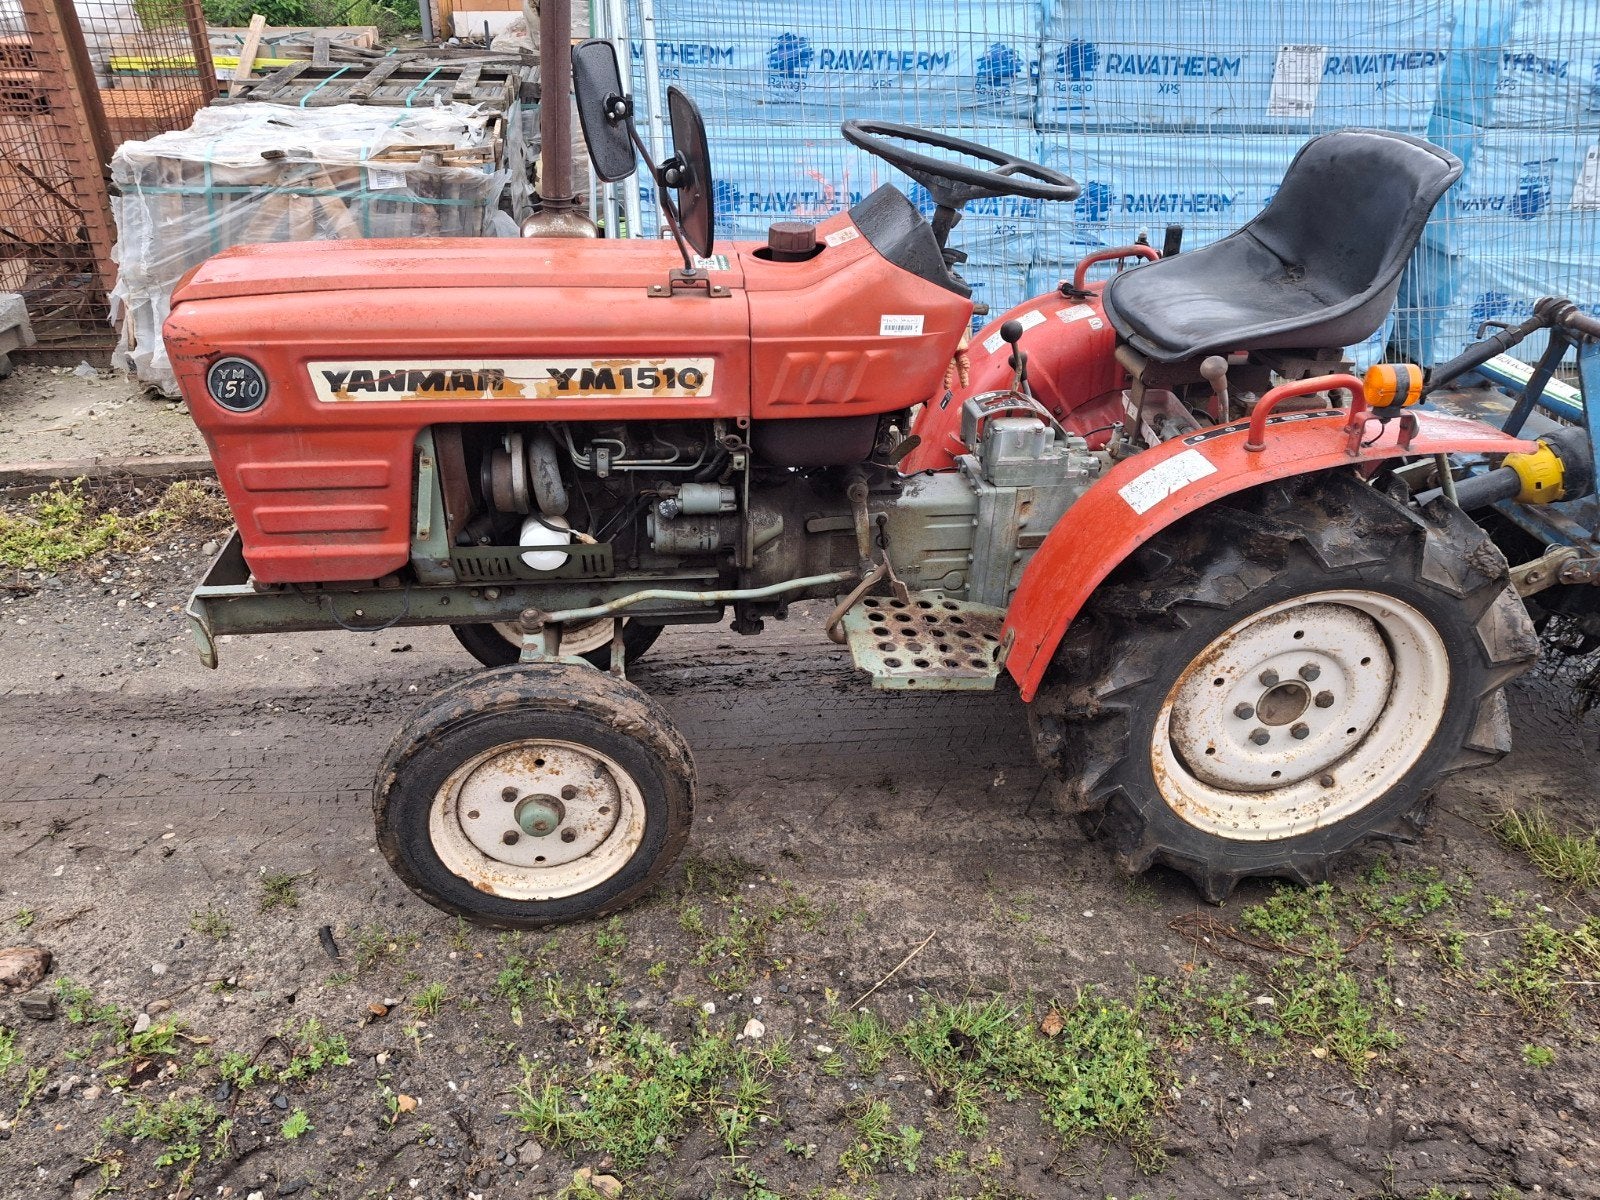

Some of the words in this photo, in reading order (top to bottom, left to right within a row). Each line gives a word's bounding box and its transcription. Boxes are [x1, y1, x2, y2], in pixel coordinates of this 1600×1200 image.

[820, 48, 950, 71] RAVATHERM
[1105, 53, 1241, 77] RAVATHERM
[1158, 82, 1181, 95] XPS
[1120, 193, 1239, 213] RAVATHERM
[994, 224, 1017, 236] XPS
[217, 368, 245, 380] YM
[321, 368, 505, 393] YANMAR
[545, 366, 704, 391] YM1510
[217, 380, 260, 399] 1510
